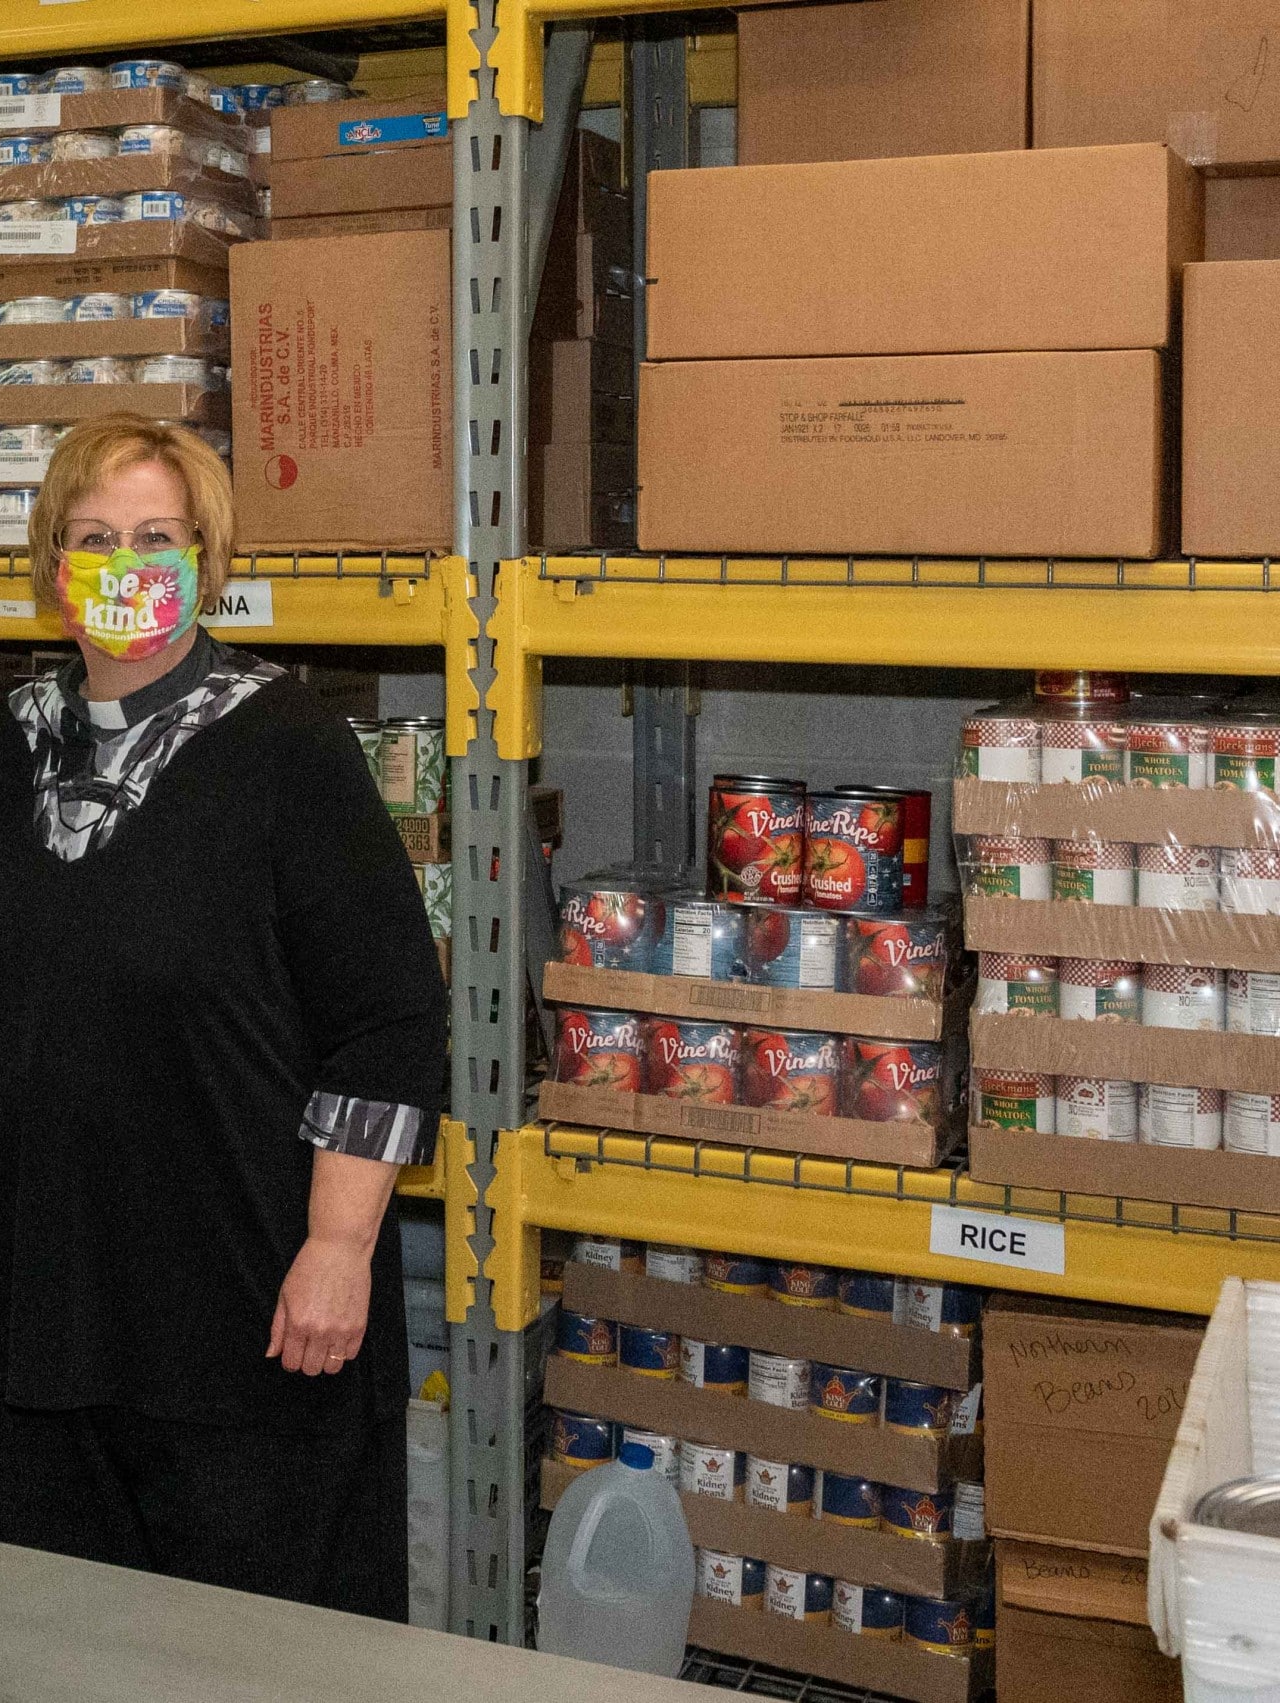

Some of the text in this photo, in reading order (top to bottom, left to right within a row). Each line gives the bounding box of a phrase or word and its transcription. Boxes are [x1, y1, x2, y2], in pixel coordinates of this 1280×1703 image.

[430, 328, 440, 342] de
[364, 340, 372, 368] LATAS
[258, 302, 275, 451] MARINDUSTRIAS
[276, 327, 291, 425] S.A. de C.V.
[306, 300, 317, 449] PARQUE INDUSTRIAL FONDEPORT
[296, 335, 306, 450] CALLE CENTRAL ORIENTE
[354, 402, 362, 413] EN
[780, 412, 800, 422] STOP
[354, 416, 363, 448] HECHO
[100, 569, 139, 598] be
[2, 605, 18, 613] Tuna
[84, 598, 159, 632] kind
[1134, 766, 1184, 776] TOMATOES
[1142, 756, 1171, 765] WHOLE
[747, 809, 793, 838] Vine
[832, 810, 879, 845] Ripe
[810, 876, 852, 892] Crushed
[566, 900, 607, 935] Ripe
[884, 938, 932, 968] Vine
[569, 1026, 616, 1054] Vine
[660, 1036, 710, 1065] Vine
[765, 1048, 816, 1076] Vine
[888, 1062, 936, 1092] Vine
[984, 1109, 1032, 1120] TOMATOES
[993, 1100, 1019, 1110] WHOLE
[960, 1224, 1026, 1256] RICE
[585, 1252, 614, 1263] Kidney
[697, 1478, 728, 1490] Kidney
[698, 1488, 726, 1498] Beans
[752, 1489, 780, 1504] Kidney
[706, 1583, 735, 1597] Kidney
[770, 1598, 798, 1613] Kidney
